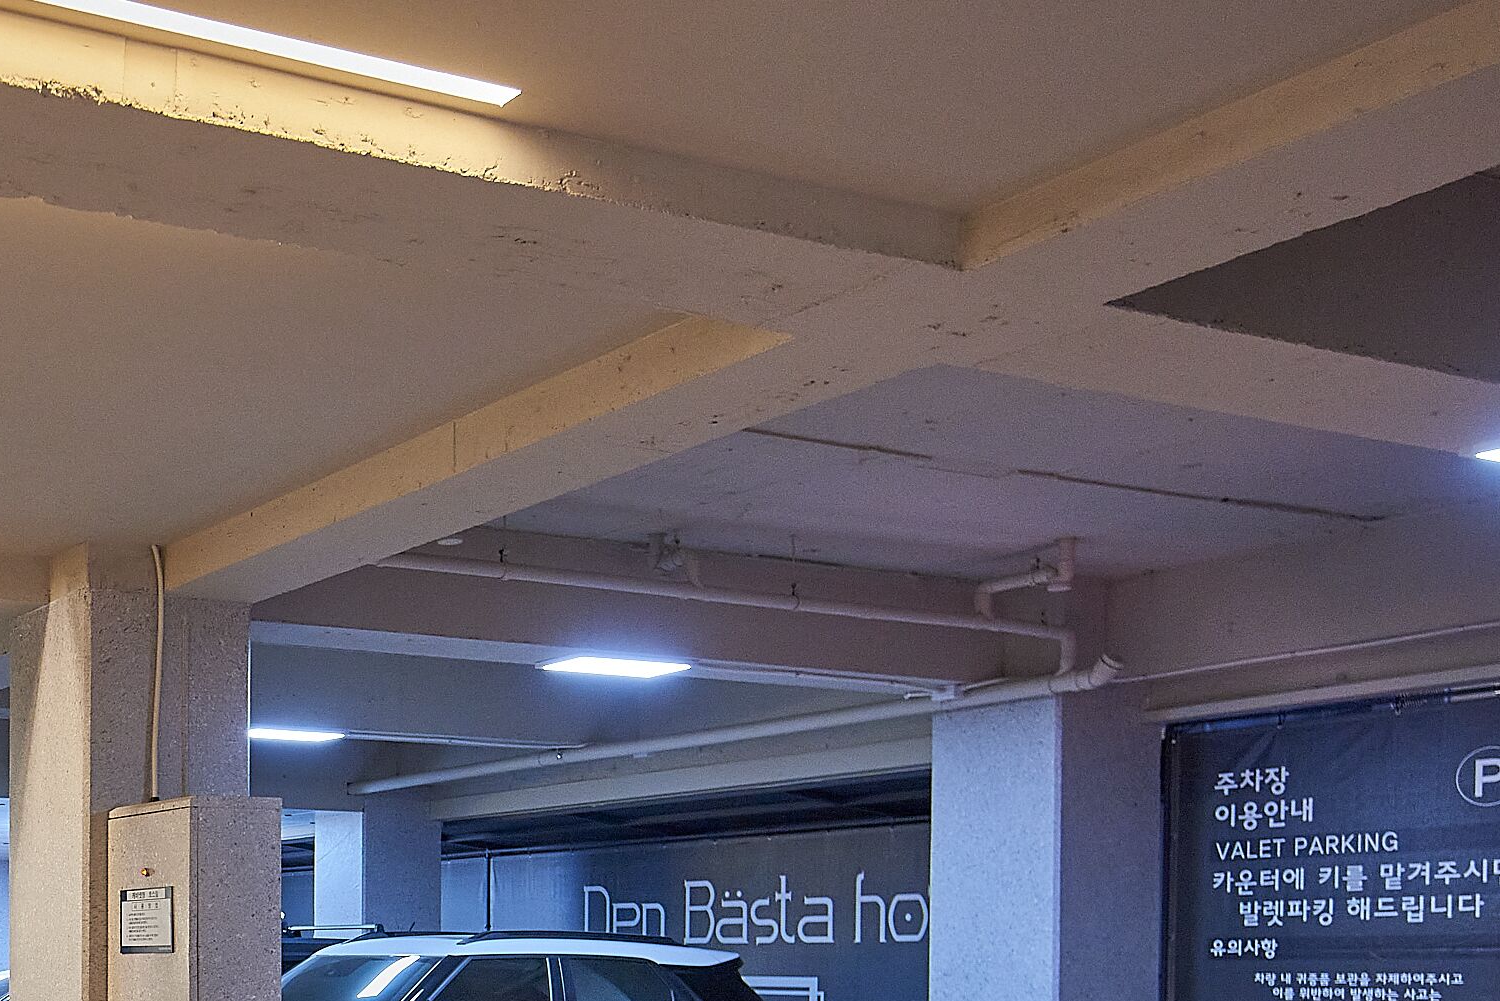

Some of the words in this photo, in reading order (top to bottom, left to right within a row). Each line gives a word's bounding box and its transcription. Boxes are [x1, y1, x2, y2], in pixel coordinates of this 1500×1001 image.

[1214, 766, 1289, 796] 주차장
[1474, 758, 1500, 798] P
[1215, 797, 1313, 831] 이용안내
[1216, 837, 1286, 860] VALET
[1294, 831, 1398, 856] PARKING
[1212, 867, 1305, 896] 카운터에
[1318, 865, 1367, 892] 키를
[1379, 858, 1500, 891] 맡겨주시
[683, 875, 835, 945] Bästa
[853, 871, 931, 943] ho
[1239, 898, 1334, 926] 발렛파킹
[1346, 892, 1485, 924] 해드립니다
[1210, 937, 1278, 960] 유의사항
[1254, 972, 1277, 987] 차량
[1280, 972, 1292, 985] 내
[1334, 972, 1371, 987] 보관을
[1375, 972, 1464, 986] 자제하여주시고
[1272, 987, 1295, 1001] 이를
[1299, 987, 1345, 1001] 위반하여
